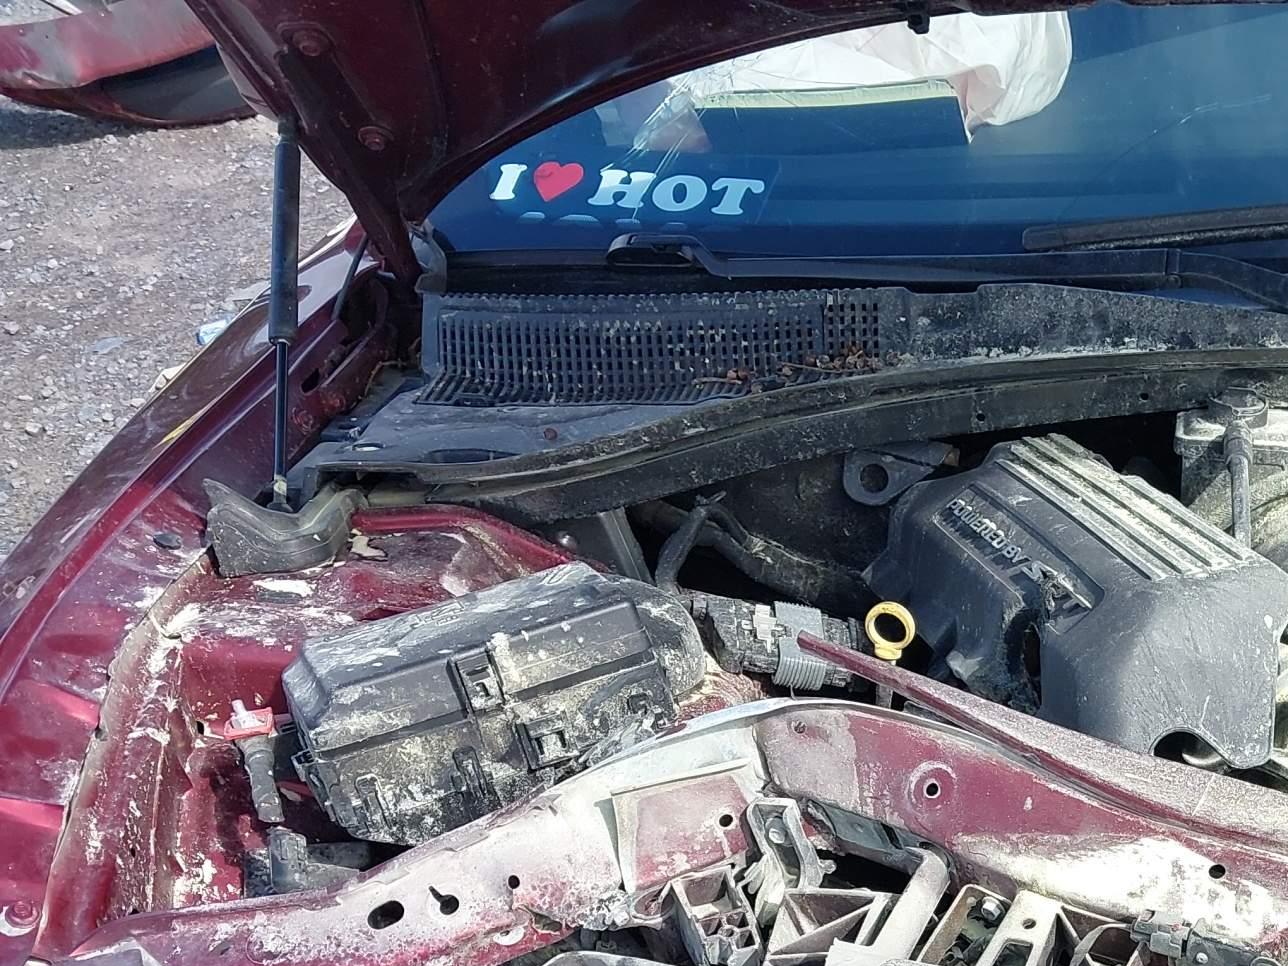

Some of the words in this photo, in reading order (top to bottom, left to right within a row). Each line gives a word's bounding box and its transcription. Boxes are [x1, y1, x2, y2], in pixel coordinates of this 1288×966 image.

[489, 163, 528, 201] I
[587, 168, 766, 216] HOT
[946, 499, 1005, 549] POWERED
[1002, 544, 1024, 563] BY
